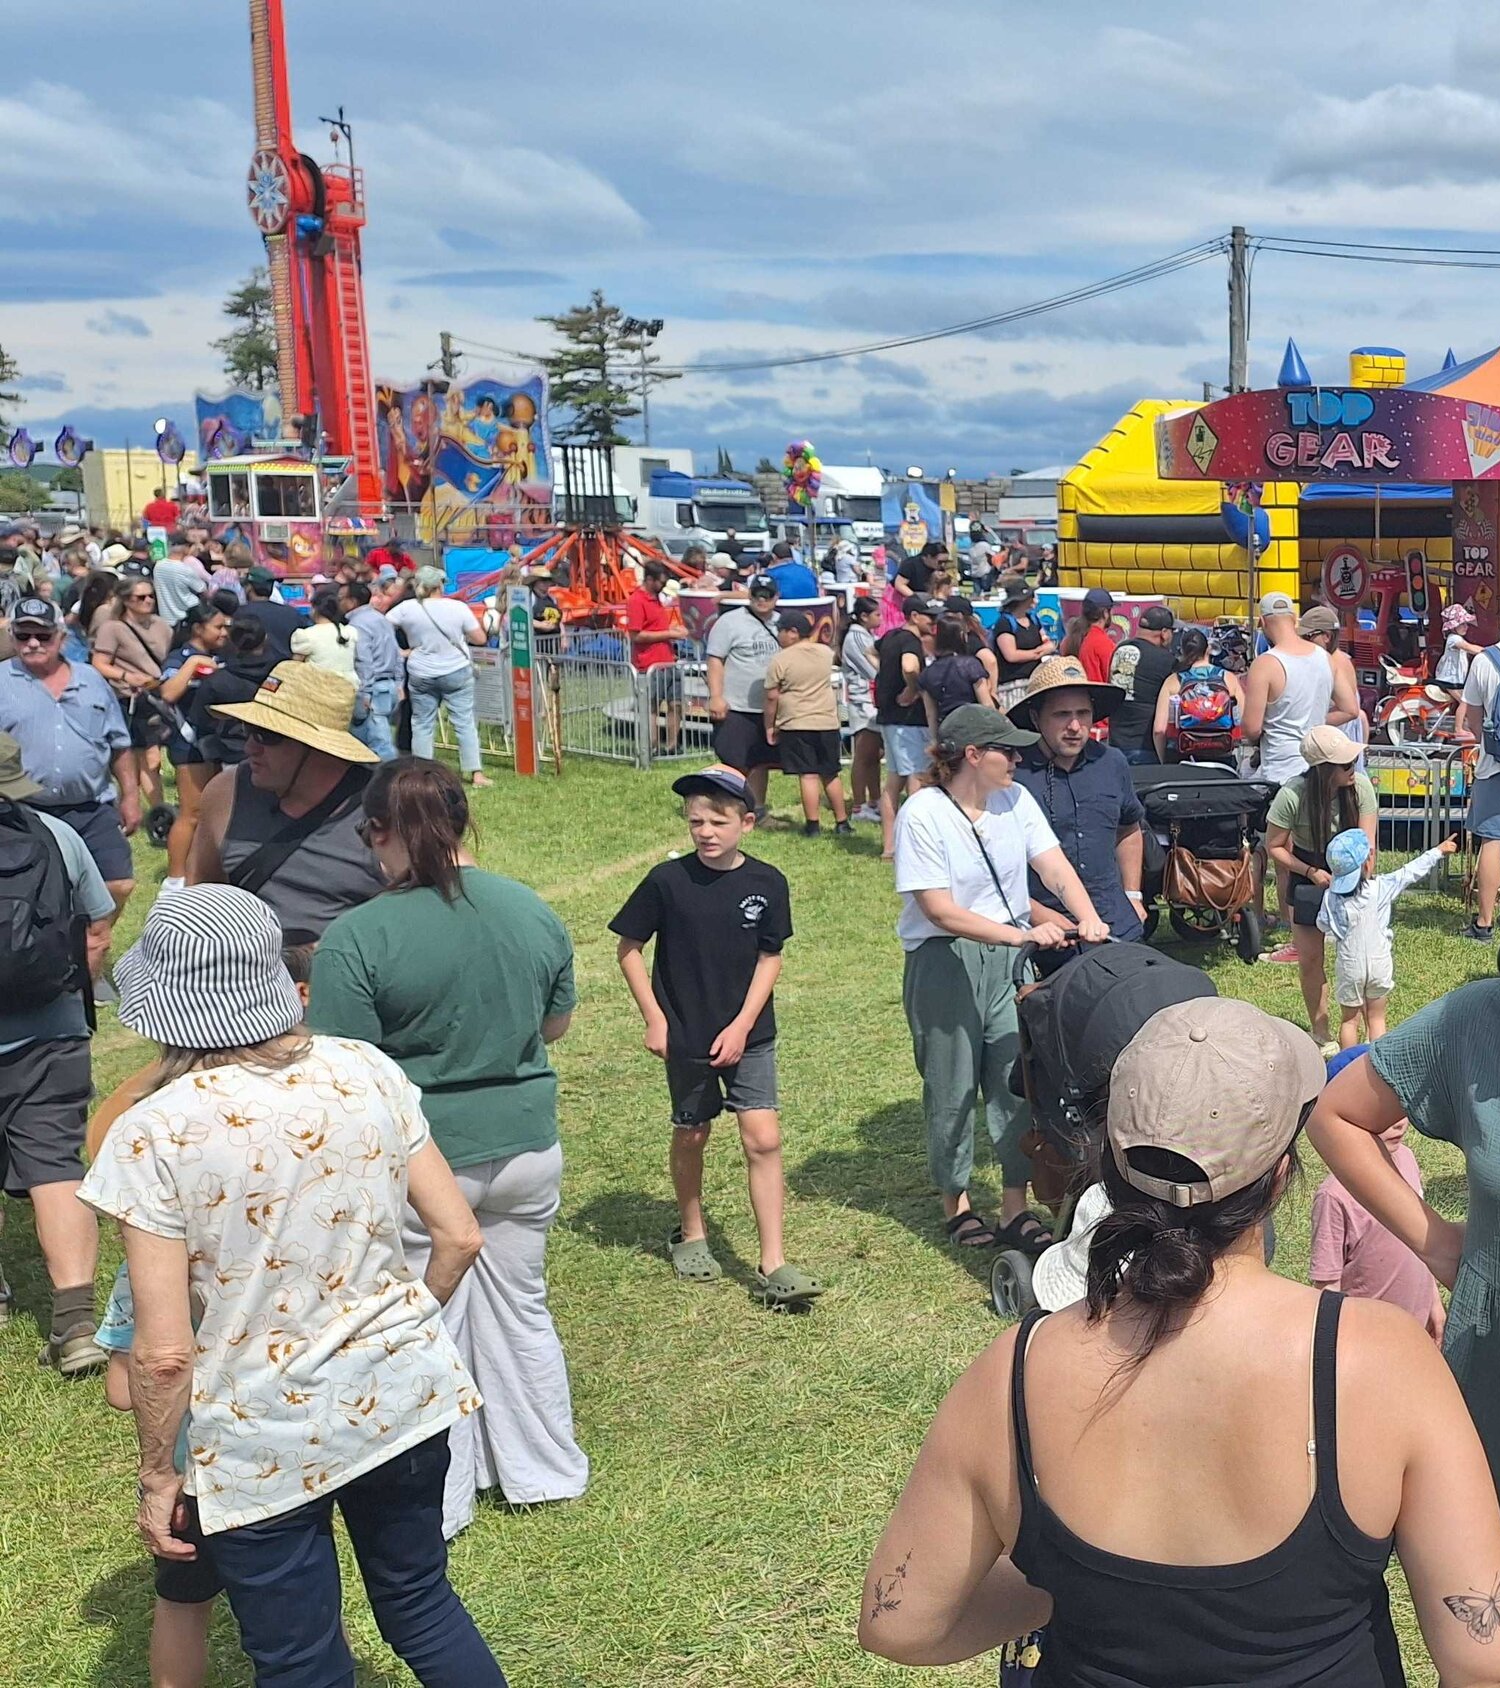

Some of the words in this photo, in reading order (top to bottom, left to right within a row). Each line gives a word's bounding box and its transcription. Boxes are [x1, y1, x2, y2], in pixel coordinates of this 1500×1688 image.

[1286, 390, 1375, 427] TOP
[1265, 431, 1401, 469] GEAR
[1463, 546, 1489, 560] TOP
[1455, 562, 1496, 577] GEAR
